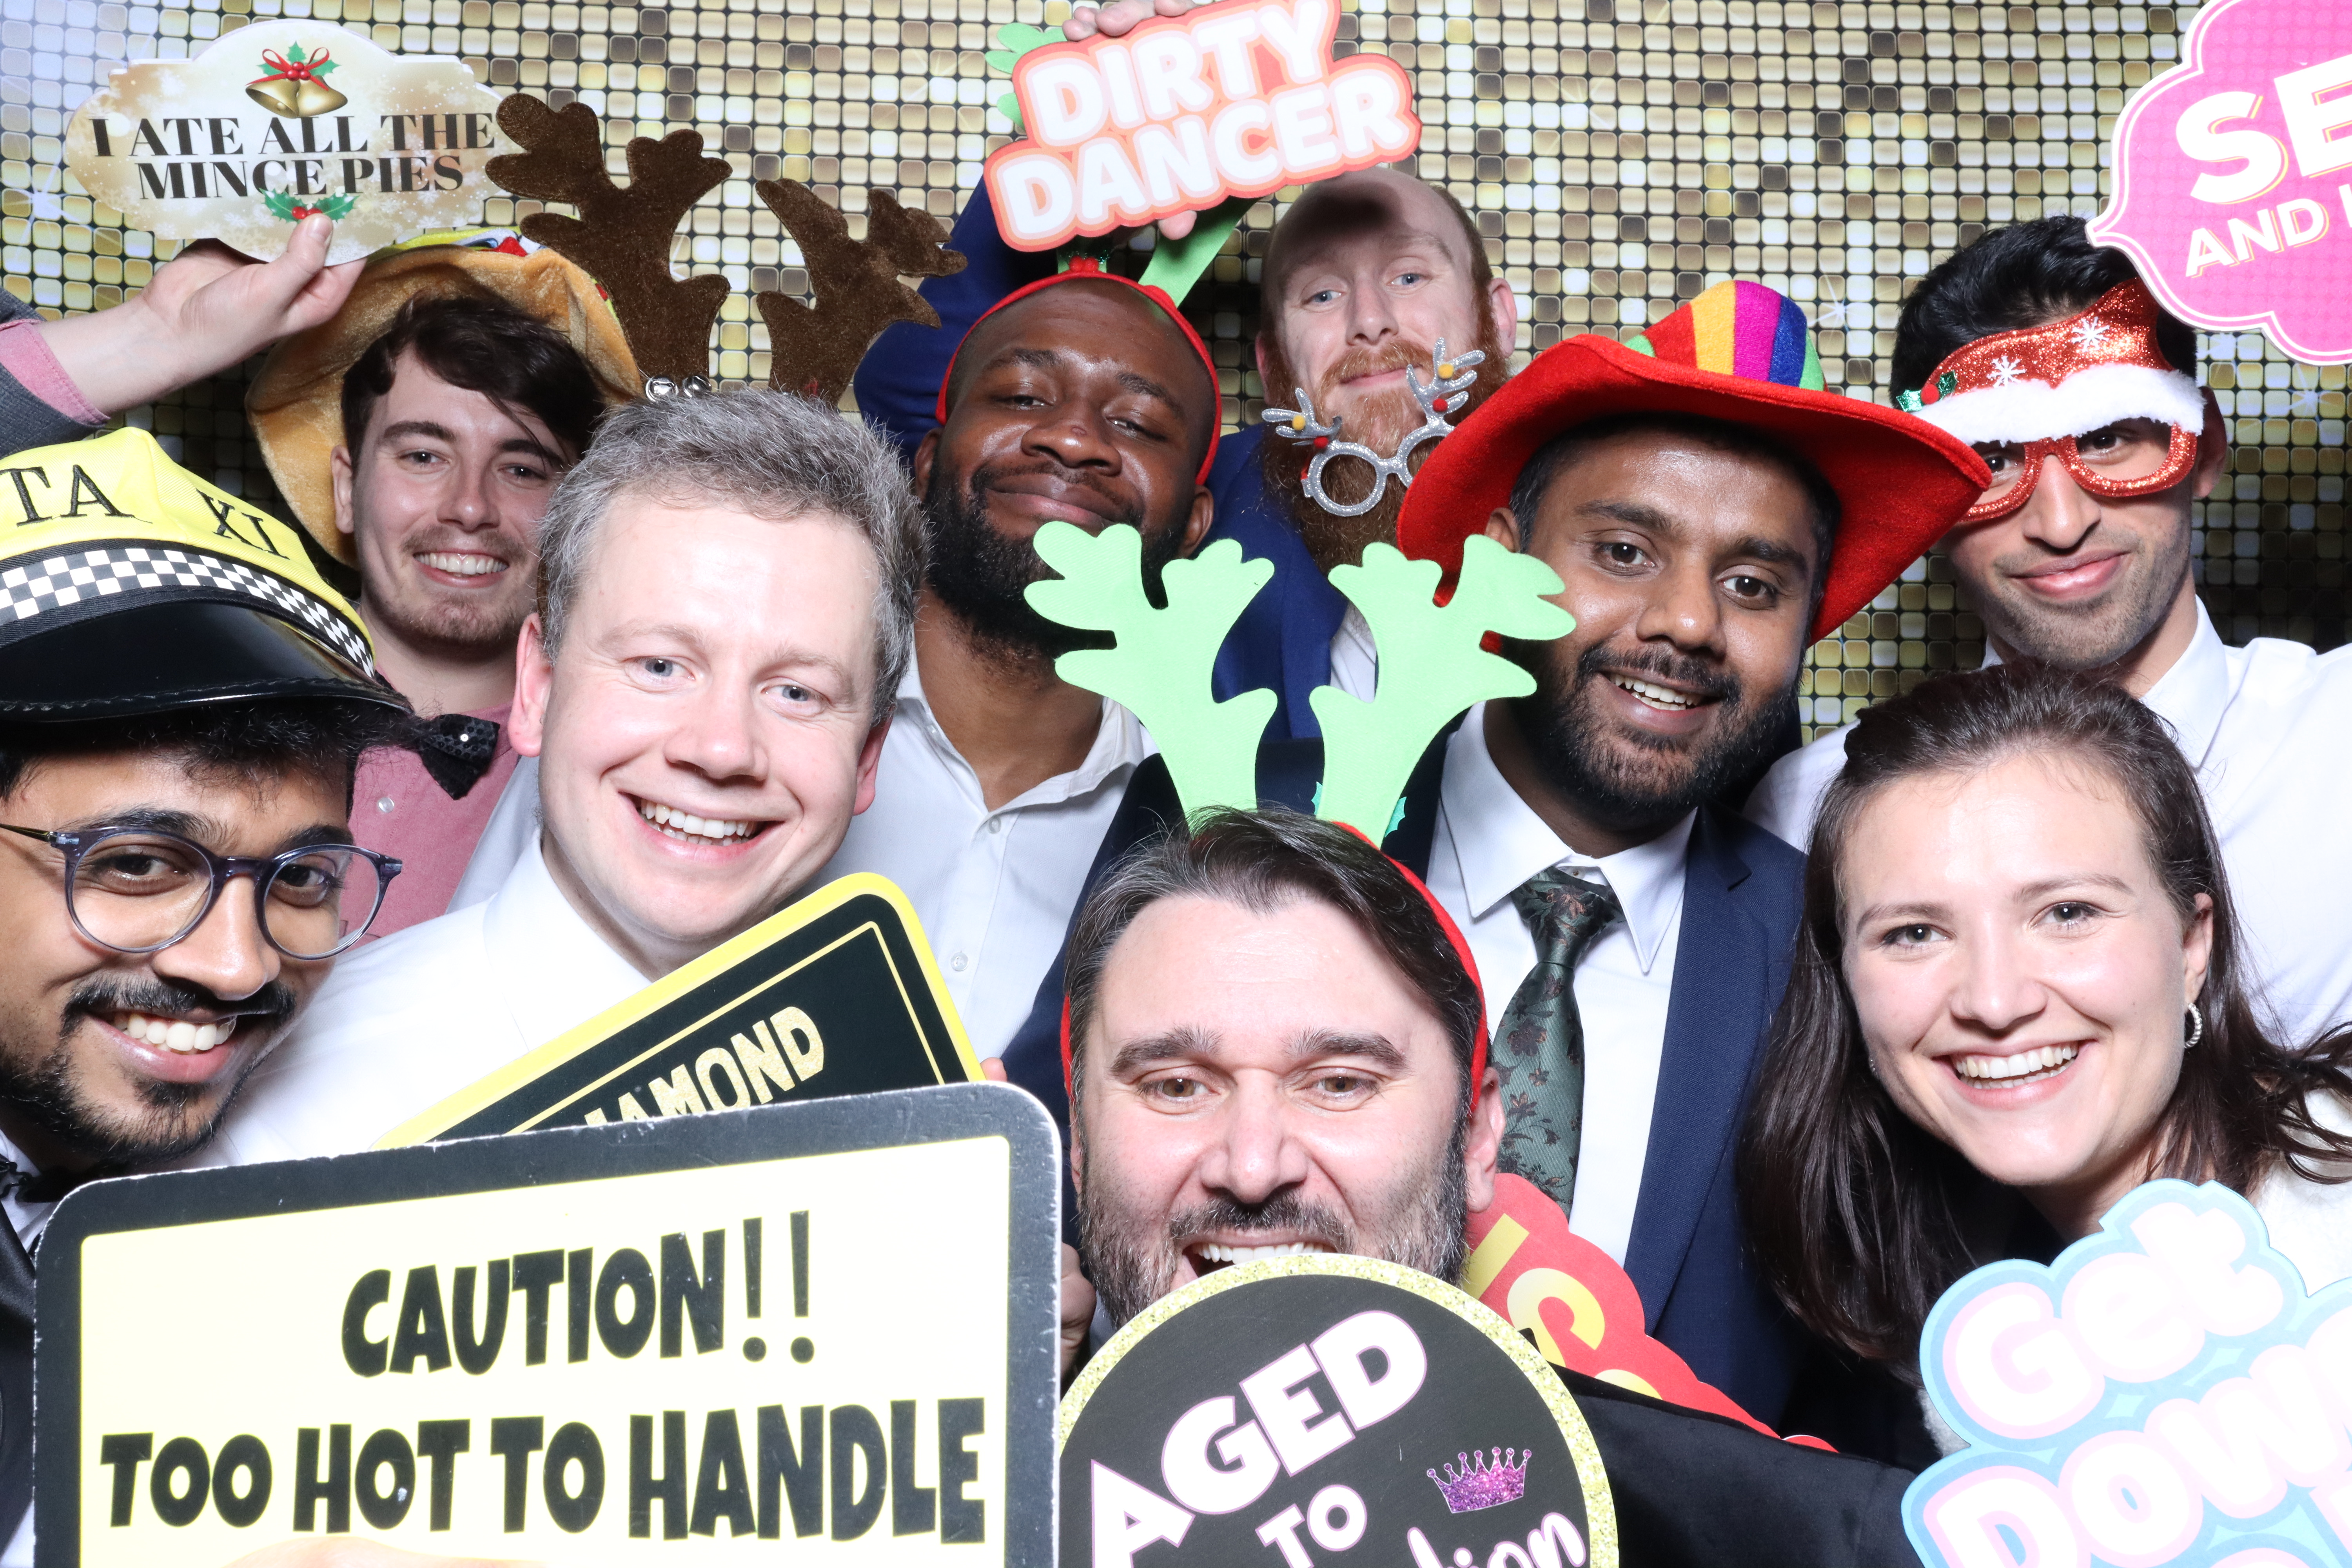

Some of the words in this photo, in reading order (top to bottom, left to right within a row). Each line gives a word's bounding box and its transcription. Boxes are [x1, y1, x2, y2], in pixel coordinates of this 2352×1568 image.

[87, 118, 113, 157] I
[130, 117, 244, 156] ATE
[258, 115, 368, 154] ALL
[380, 113, 495, 152] THE
[1025, 0, 1327, 146] DIRTY
[134, 155, 329, 200] MINCE
[338, 155, 464, 195] PIES
[999, 71, 1410, 236] DANCER
[2185, 198, 2329, 278] AND
[341, 1210, 815, 1377] CAUTION!!
[1949, 1207, 2278, 1433] Get
[100, 1432, 272, 1528] TOO
[293, 1419, 470, 1533] HOT
[491, 1416, 605, 1533] TO
[628, 1396, 985, 1544] HANDLE
[1091, 1310, 1427, 1568] AGED
[1255, 1485, 1367, 1568] TO
